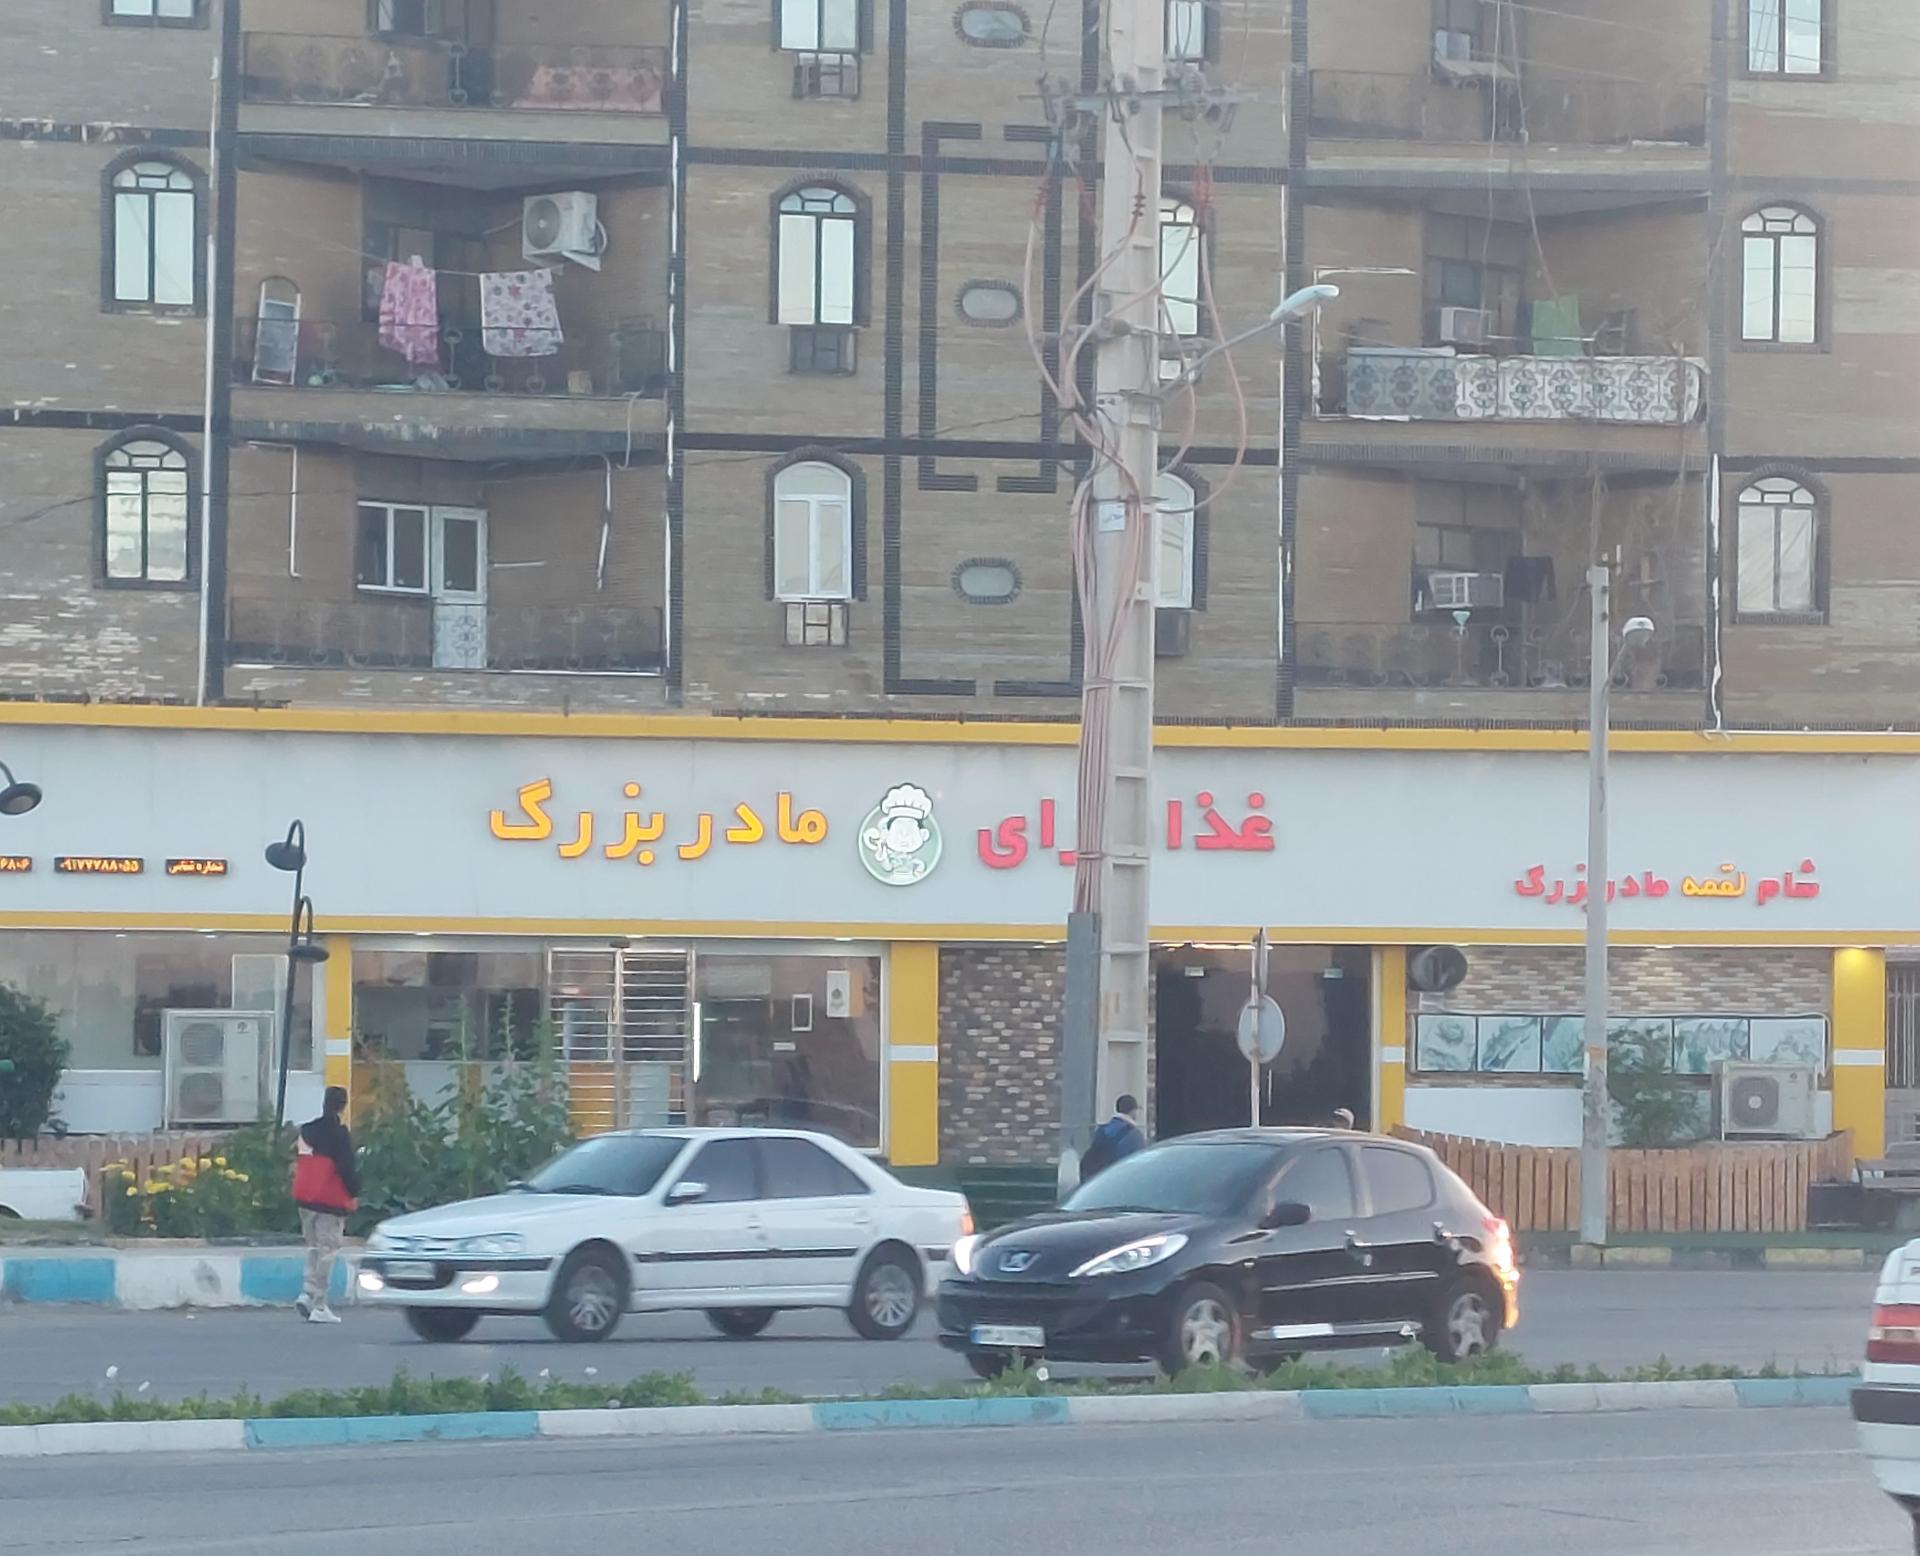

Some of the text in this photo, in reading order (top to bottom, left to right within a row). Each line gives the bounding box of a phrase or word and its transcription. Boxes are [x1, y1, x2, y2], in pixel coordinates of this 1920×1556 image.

[1167, 791, 1276, 851] غذا
[1680, 862, 1746, 897] لقمه
[1756, 858, 1820, 905] شام
